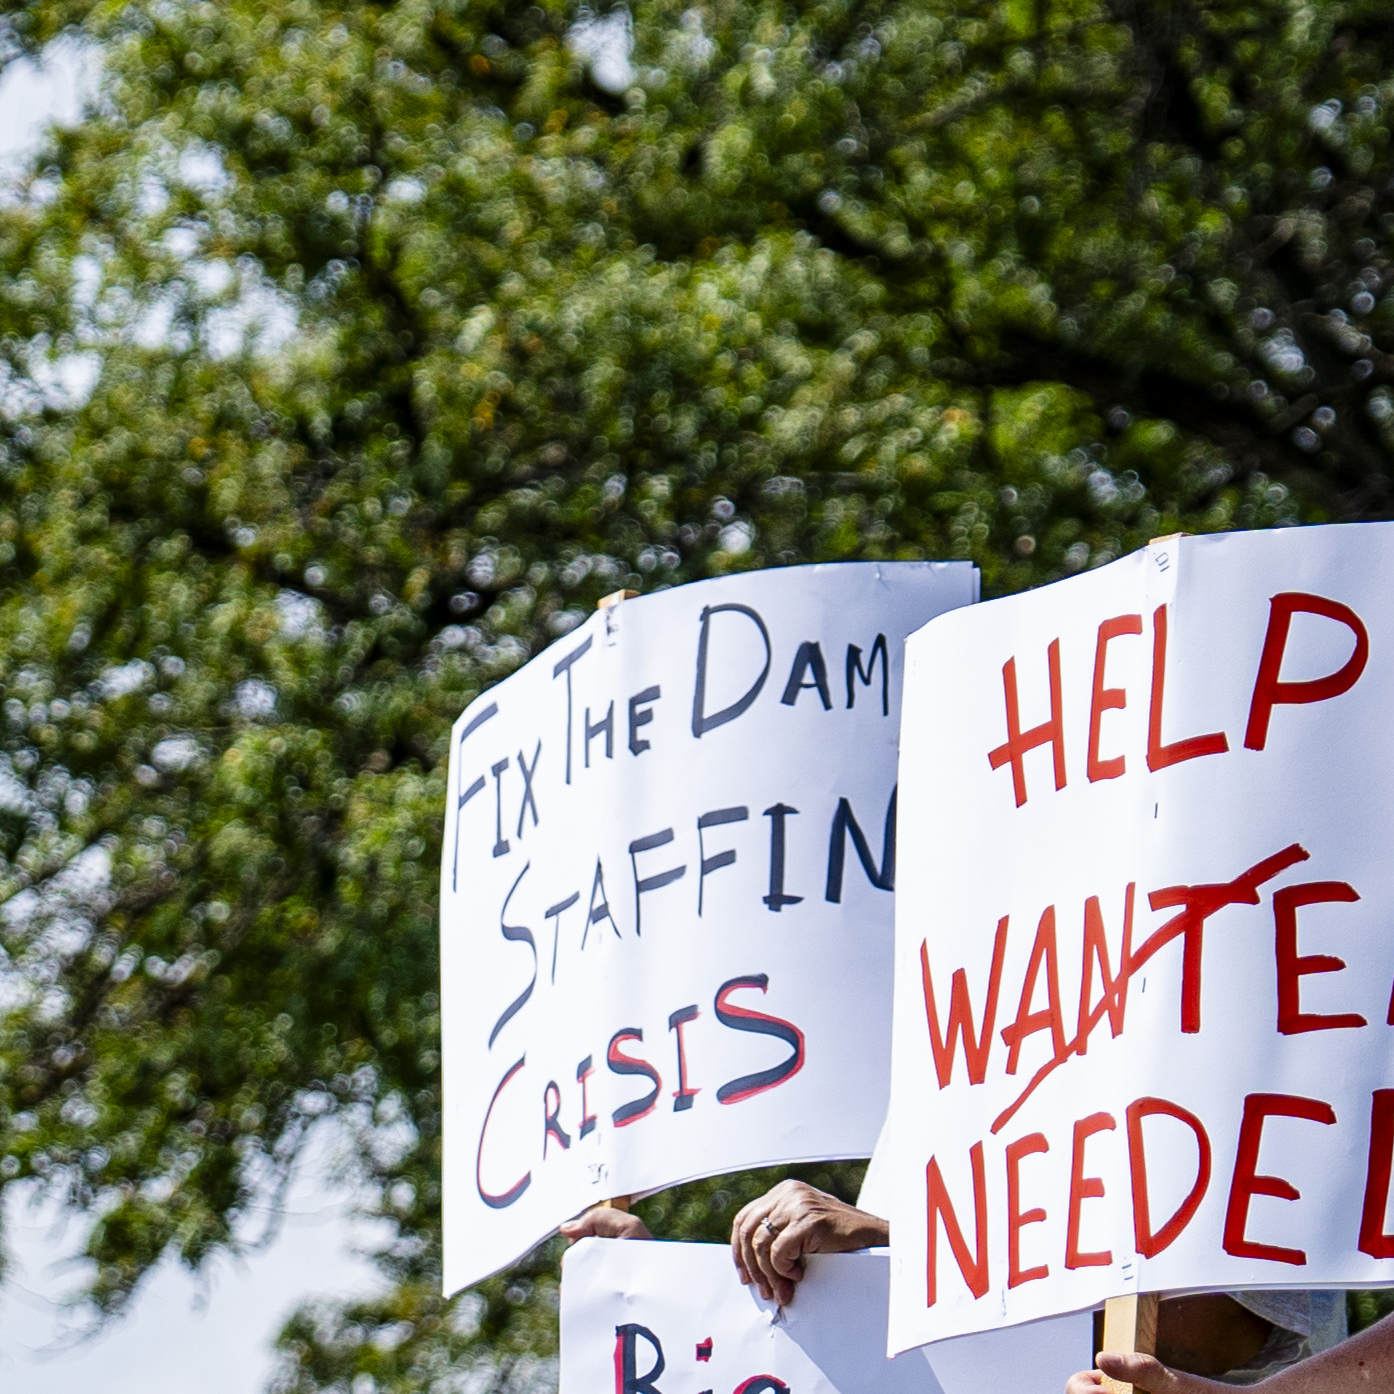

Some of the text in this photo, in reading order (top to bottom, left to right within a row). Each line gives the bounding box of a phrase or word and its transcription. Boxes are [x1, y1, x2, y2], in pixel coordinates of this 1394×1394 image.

[450, 602, 890, 892] FIX THE DAM
[987, 592, 1370, 807] HELP
[476, 972, 806, 1209] CRISIS
